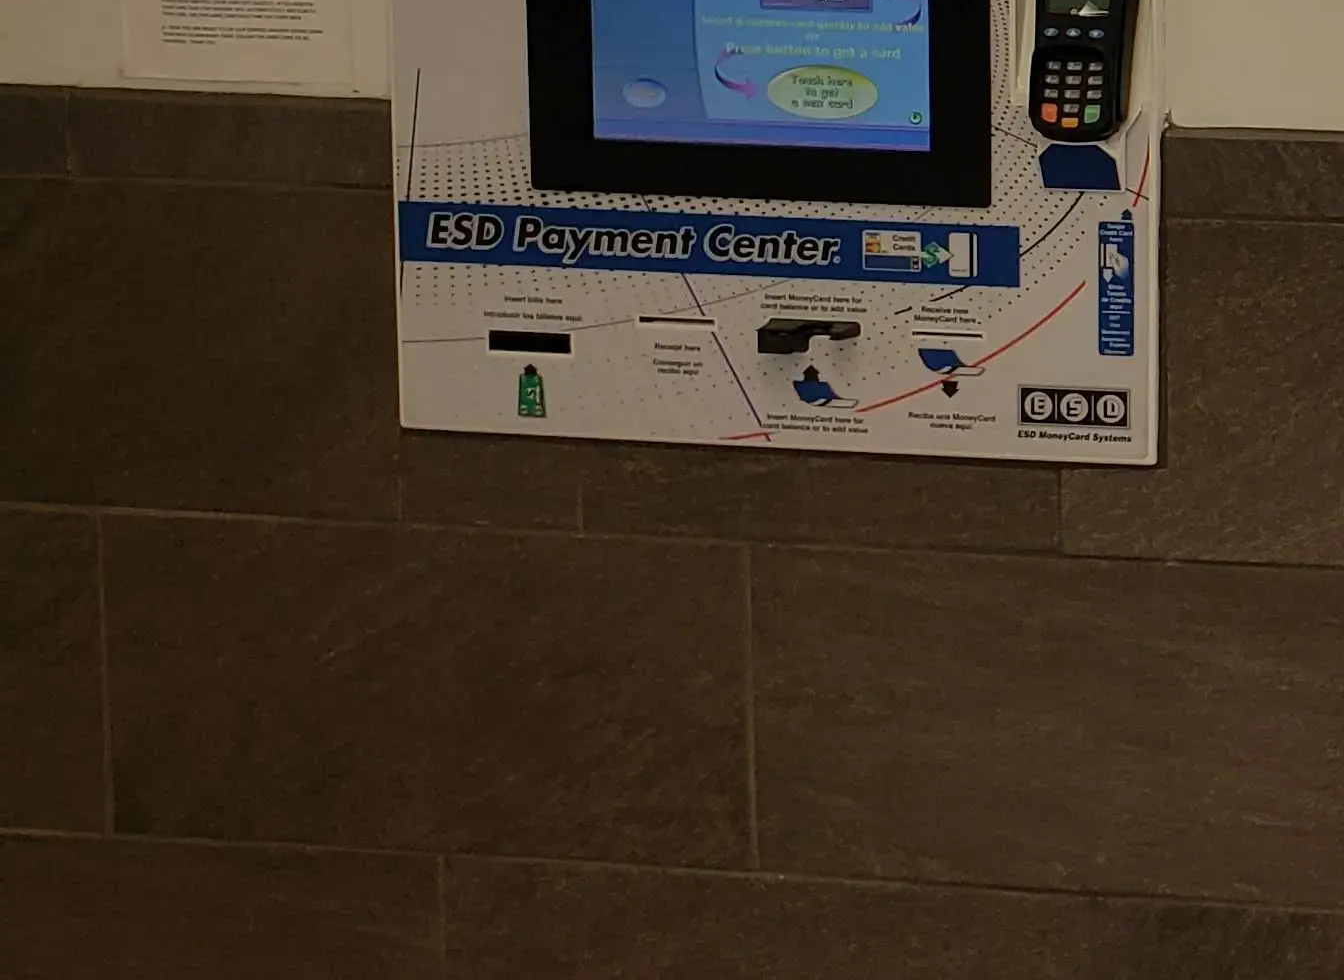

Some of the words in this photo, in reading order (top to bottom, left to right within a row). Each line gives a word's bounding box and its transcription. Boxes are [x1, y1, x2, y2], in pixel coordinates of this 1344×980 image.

[426, 212, 503, 248] ESD
[512, 215, 696, 264] Payment
[788, 295, 831, 304] MoneyCard
[852, 296, 862, 304] for
[1018, 430, 1036, 438] ESD
[1039, 432, 1089, 441] MoneyCard
[1093, 433, 1131, 443] Systems
